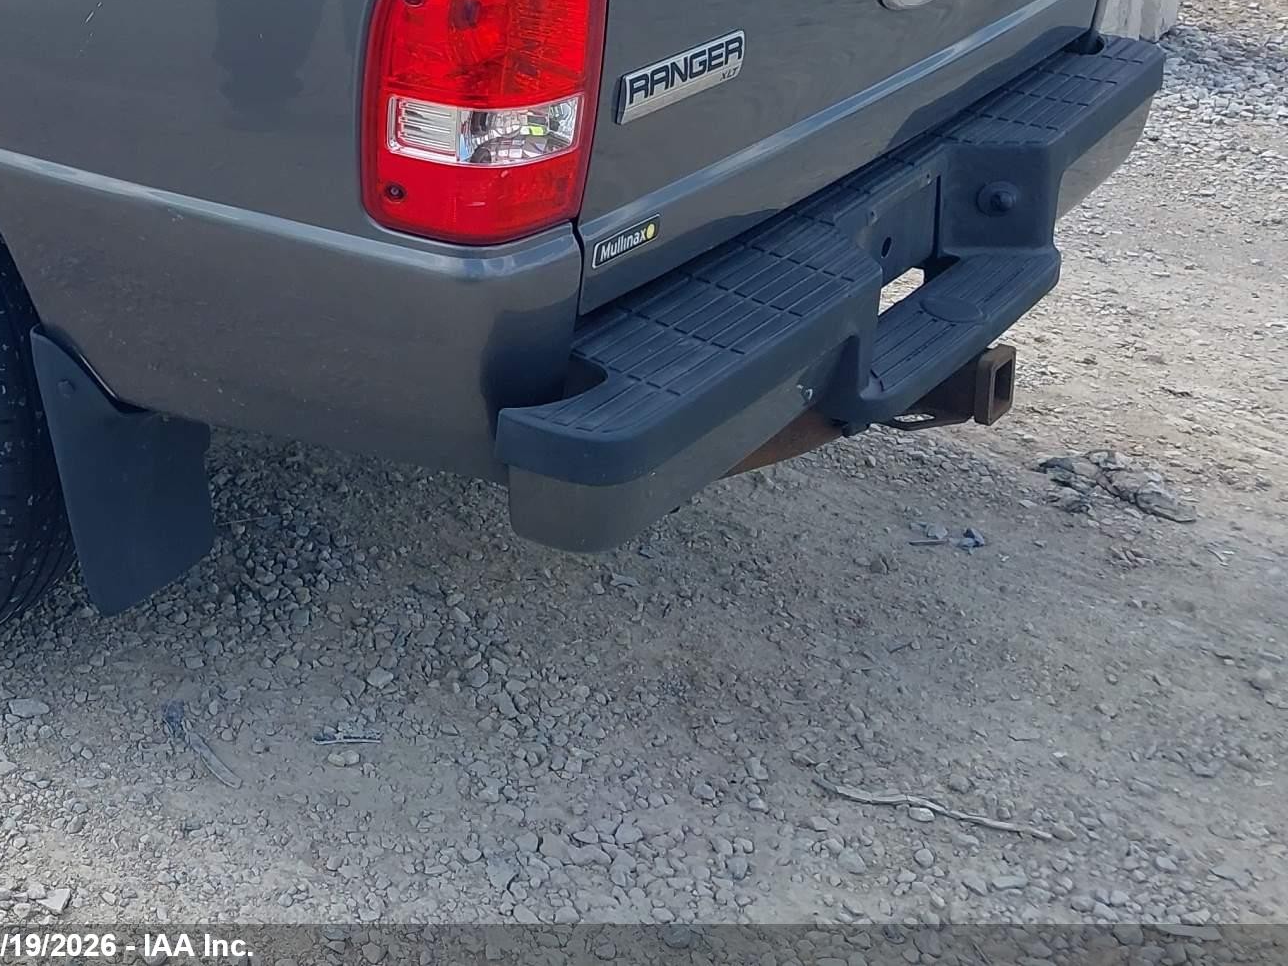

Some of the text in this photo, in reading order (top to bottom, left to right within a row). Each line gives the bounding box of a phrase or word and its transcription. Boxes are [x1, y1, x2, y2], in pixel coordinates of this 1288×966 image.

[628, 36, 743, 105] RANGER
[719, 67, 740, 81] XLT
[600, 227, 648, 262] Mullinax
